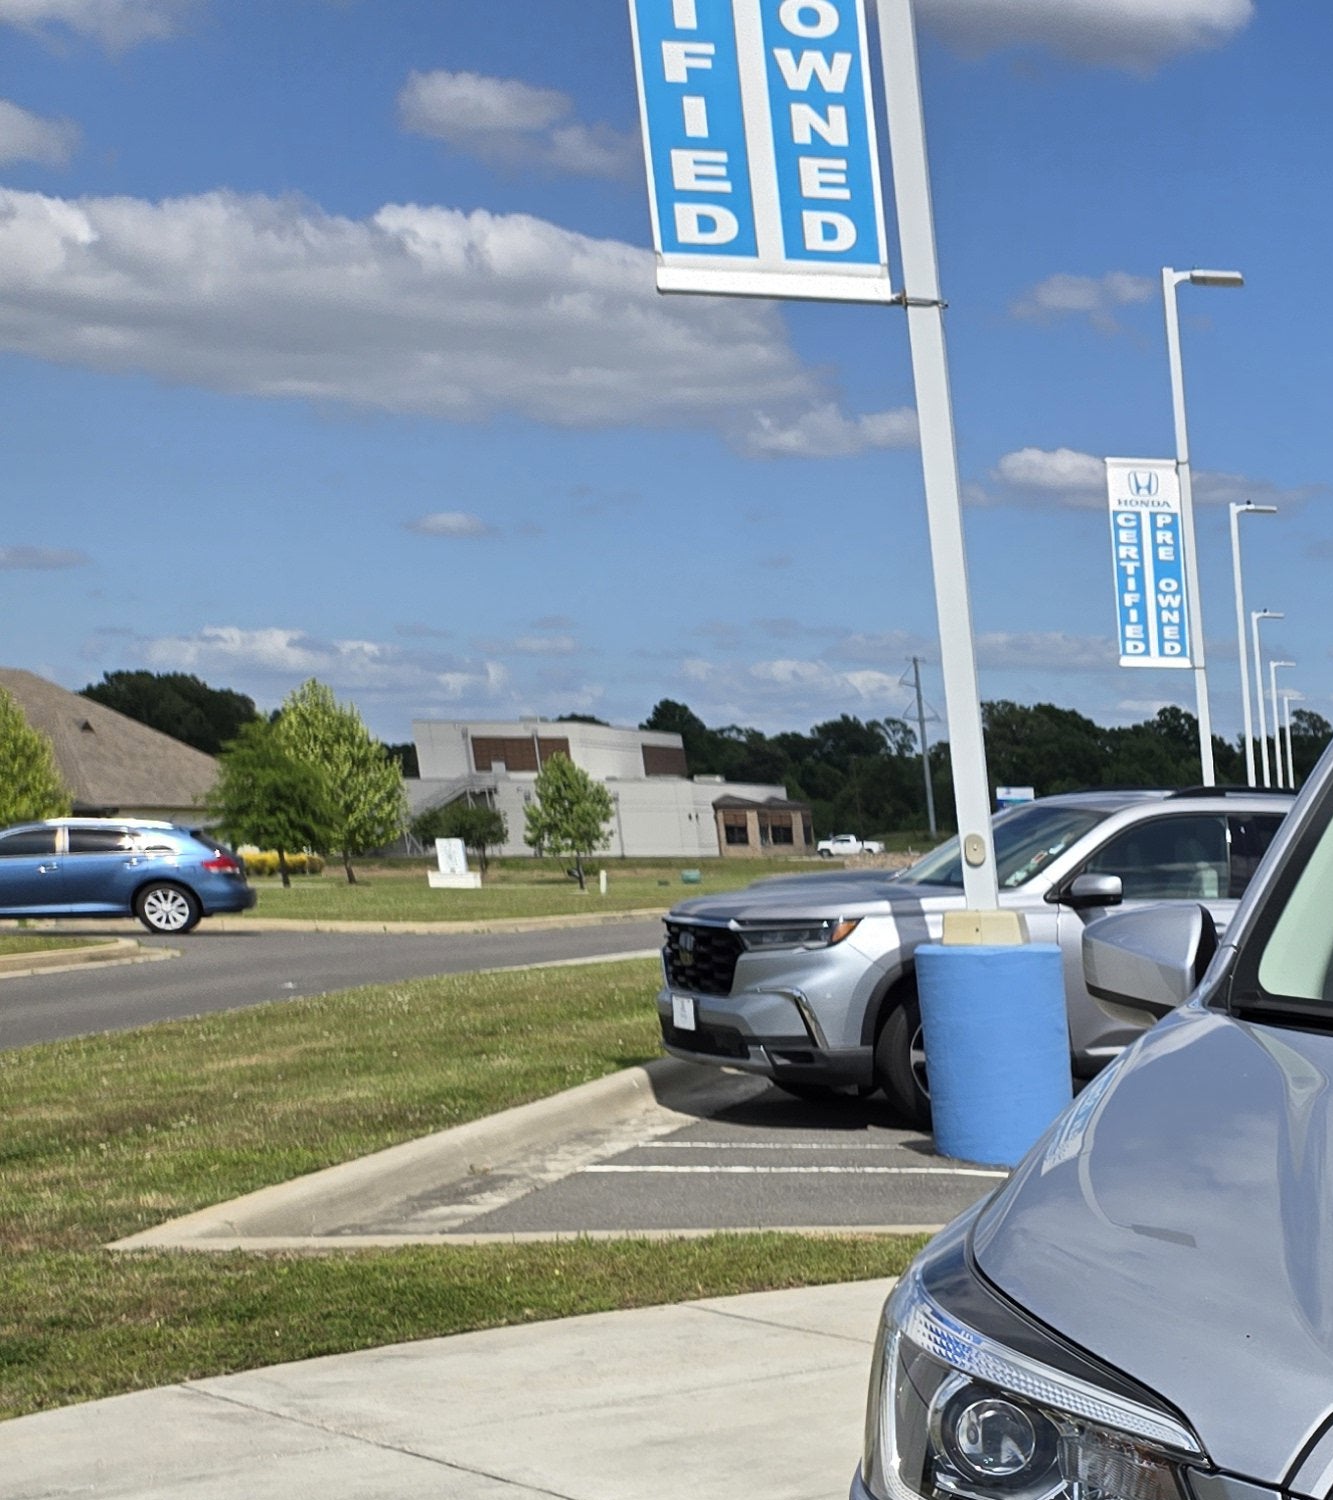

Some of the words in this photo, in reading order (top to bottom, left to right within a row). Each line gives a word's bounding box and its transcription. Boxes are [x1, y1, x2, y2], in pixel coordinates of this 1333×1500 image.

[773, 0, 857, 252] OWNED
[1117, 499, 1172, 509] HONDA
[1156, 514, 1175, 561] PRE
[1116, 512, 1146, 654] CERTIFIED
[1157, 578, 1182, 656] OWNED
